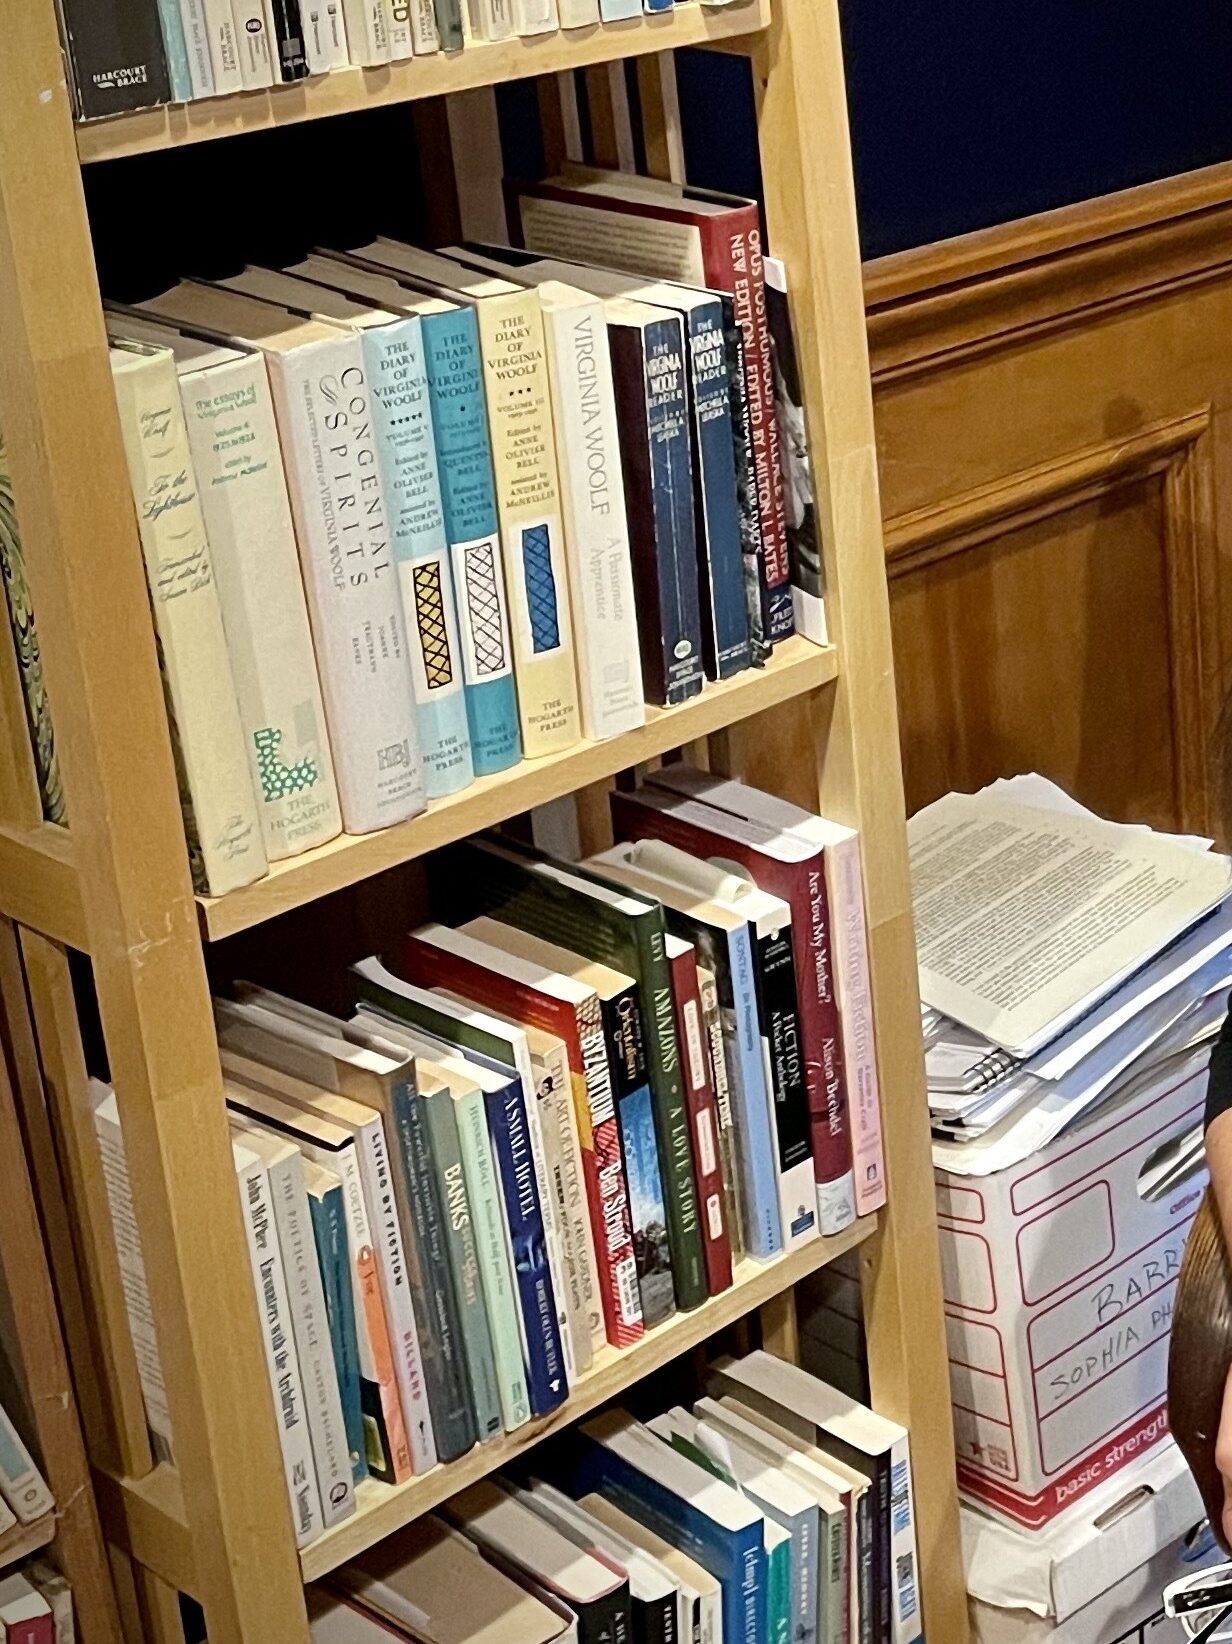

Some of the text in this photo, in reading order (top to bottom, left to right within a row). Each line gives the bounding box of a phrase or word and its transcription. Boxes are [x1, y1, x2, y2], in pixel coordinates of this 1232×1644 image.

[92, 64, 147, 83] HARCOURT
[117, 75, 148, 88] BRACE
[501, 316, 525, 329] THE
[697, 319, 714, 331] THE
[442, 333, 469, 346] THE
[495, 327, 533, 343] DIARY
[689, 328, 725, 354] VIRGINIA
[386, 341, 410, 356] THE
[436, 344, 476, 361] DIARY
[507, 341, 524, 353] OF
[652, 343, 670, 355] THE
[380, 353, 417, 371] DIARY
[449, 359, 467, 372] OF
[487, 350, 543, 369] VIRGINIA
[647, 352, 683, 378] VIRGINIA
[695, 348, 723, 371] WOOLF
[393, 369, 409, 381] OF
[496, 364, 539, 381] WOOLF
[650, 372, 681, 395] WOOLF
[373, 377, 428, 398] VIRGINIA
[436, 381, 481, 400] WOOLF
[381, 390, 424, 411] WOOLF
[497, 400, 533, 413] VOLUME
[730, 234, 780, 584] NEW EDITION EDITED BY MILTON BATES
[747, 230, 790, 576] OPUS POSTHUMOUS WALLACE STEVENS
[573, 315, 611, 516] VIRGINIA WOOLF
[507, 424, 543, 437] Edited by
[505, 445, 546, 461] OLIVIER
[512, 436, 539, 448] ANNE
[395, 451, 429, 466] Edited by
[401, 462, 427, 476] ANNE
[517, 457, 540, 469] BELL
[341, 367, 391, 579] CONGENIAL
[393, 471, 434, 489] OLIVIER
[457, 465, 483, 476] BELL
[540, 471, 549, 480] by
[325, 410, 368, 587] SPIRITS
[405, 486, 429, 498] BELL
[460, 493, 486, 504] ANNE
[510, 481, 551, 497] ANDREW
[319, 487, 339, 545] VIRGINIA
[400, 508, 440, 526] ANDREW
[451, 502, 494, 518] OLIVIER
[463, 515, 487, 528] BELL
[328, 544, 346, 592] WOOLF
[590, 548, 607, 620] Apprentice
[606, 537, 624, 622] A Passionate
[528, 706, 574, 724] HOGARTH
[542, 700, 562, 711] THE
[540, 719, 568, 732] PRESS
[422, 742, 469, 764] HOGARTH
[437, 736, 458, 748] THE
[435, 755, 464, 771] PRESS
[287, 795, 312, 812] THE
[270, 802, 331, 831] HOGARTH
[288, 822, 323, 842] PRESS
[734, 933, 750, 986] SONTAG
[847, 910, 864, 987] Writing
[809, 872, 843, 1137] Are You My Mother? Alison Bechdel
[654, 987, 679, 1073] AMAZONS
[850, 987, 869, 1061] Fiction
[772, 1011, 789, 1102] A Pocket Anthology
[783, 1013, 800, 1087] FICTION
[551, 1060, 564, 1091] THE
[580, 1029, 615, 1128] BYZANTIUM
[505, 1096, 519, 1111] A
[556, 1098, 569, 1123] ART
[670, 1107, 683, 1119] A
[717, 1095, 734, 1131] TIME
[468, 1105, 484, 1158] HEINRICH
[508, 1111, 527, 1165] SMALL
[559, 1123, 571, 1143] OF
[671, 1124, 690, 1172] LOVE
[563, 1142, 581, 1209] FICTION
[599, 1158, 622, 1198] Ben
[247, 1174, 262, 1206] John
[282, 1173, 295, 1204] THE
[444, 1163, 469, 1231] BANKS
[514, 1161, 536, 1216] HOTEL
[350, 1181, 367, 1239] COETZEE
[677, 1176, 697, 1233] STORY
[251, 1202, 271, 1250] McPhee
[572, 1216, 586, 1248] JOHN
[602, 1194, 632, 1253] Stroud
[287, 1210, 307, 1273] POETICS
[371, 1133, 422, 1401] LIVING BY FICTION DILLARD
[260, 1256, 281, 1327] Encounters
[299, 1279, 311, 1296] OF
[302, 1303, 318, 1347] SPACE
[268, 1322, 287, 1352] with
[275, 1351, 290, 1372] the
[1050, 1302, 1172, 1400] SOPHIA PH
[1055, 1461, 1102, 1503] basic
